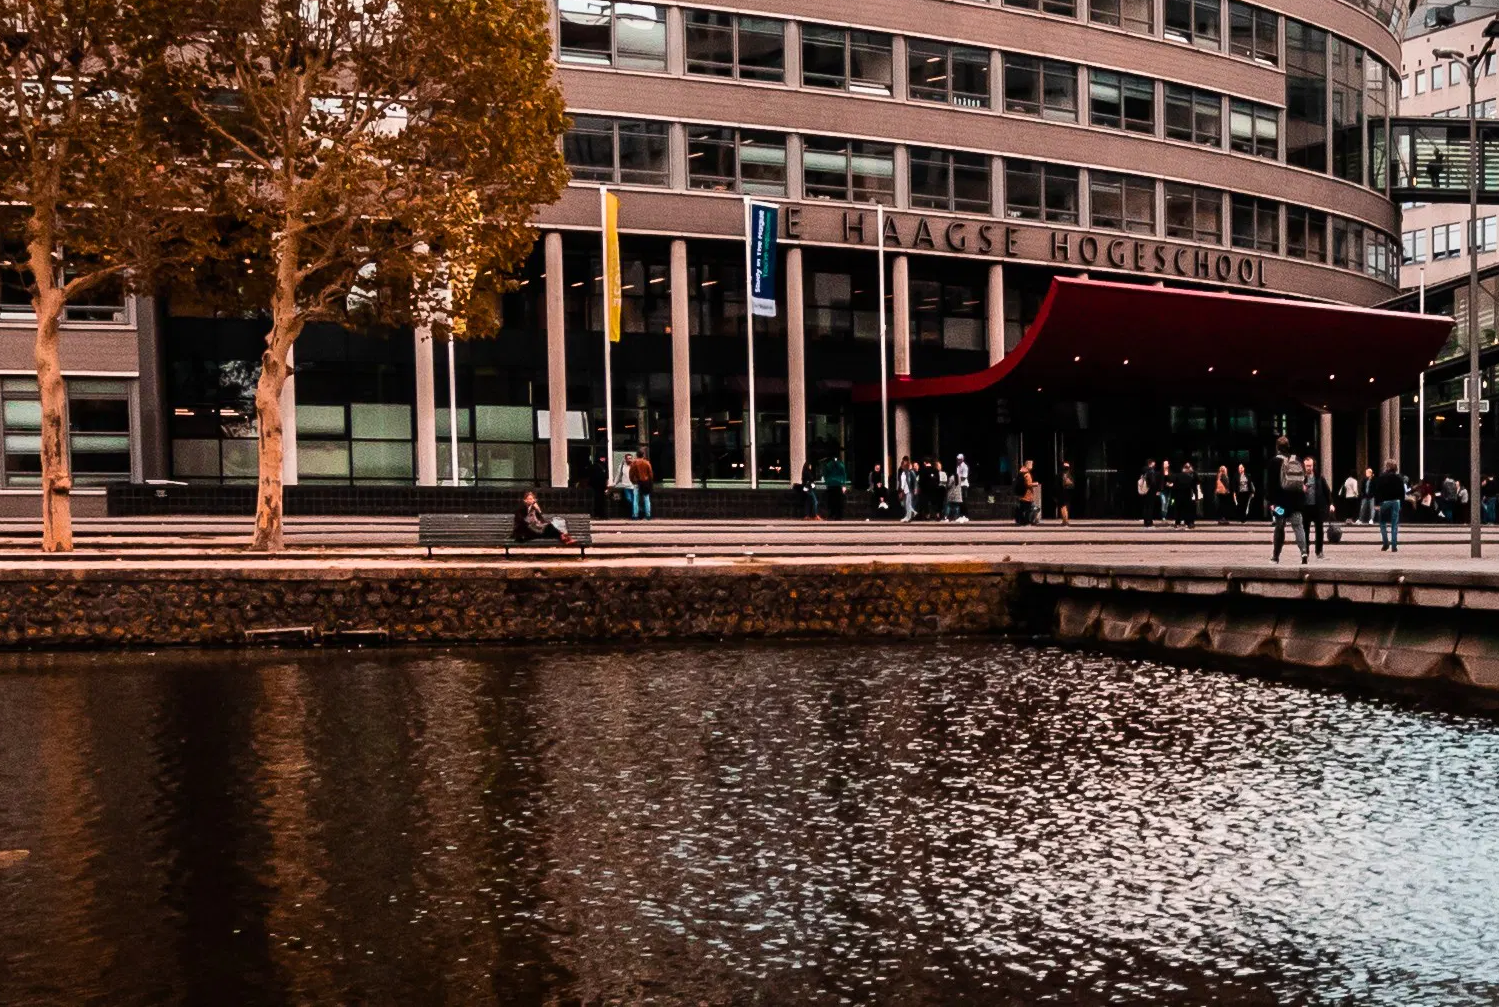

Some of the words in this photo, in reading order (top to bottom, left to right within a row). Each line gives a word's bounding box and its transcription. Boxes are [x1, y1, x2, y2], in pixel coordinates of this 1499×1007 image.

[757, 209, 765, 240] Hague
[842, 210, 1019, 256] HAAGSE
[1051, 230, 1268, 288] HOGESCHOOL
